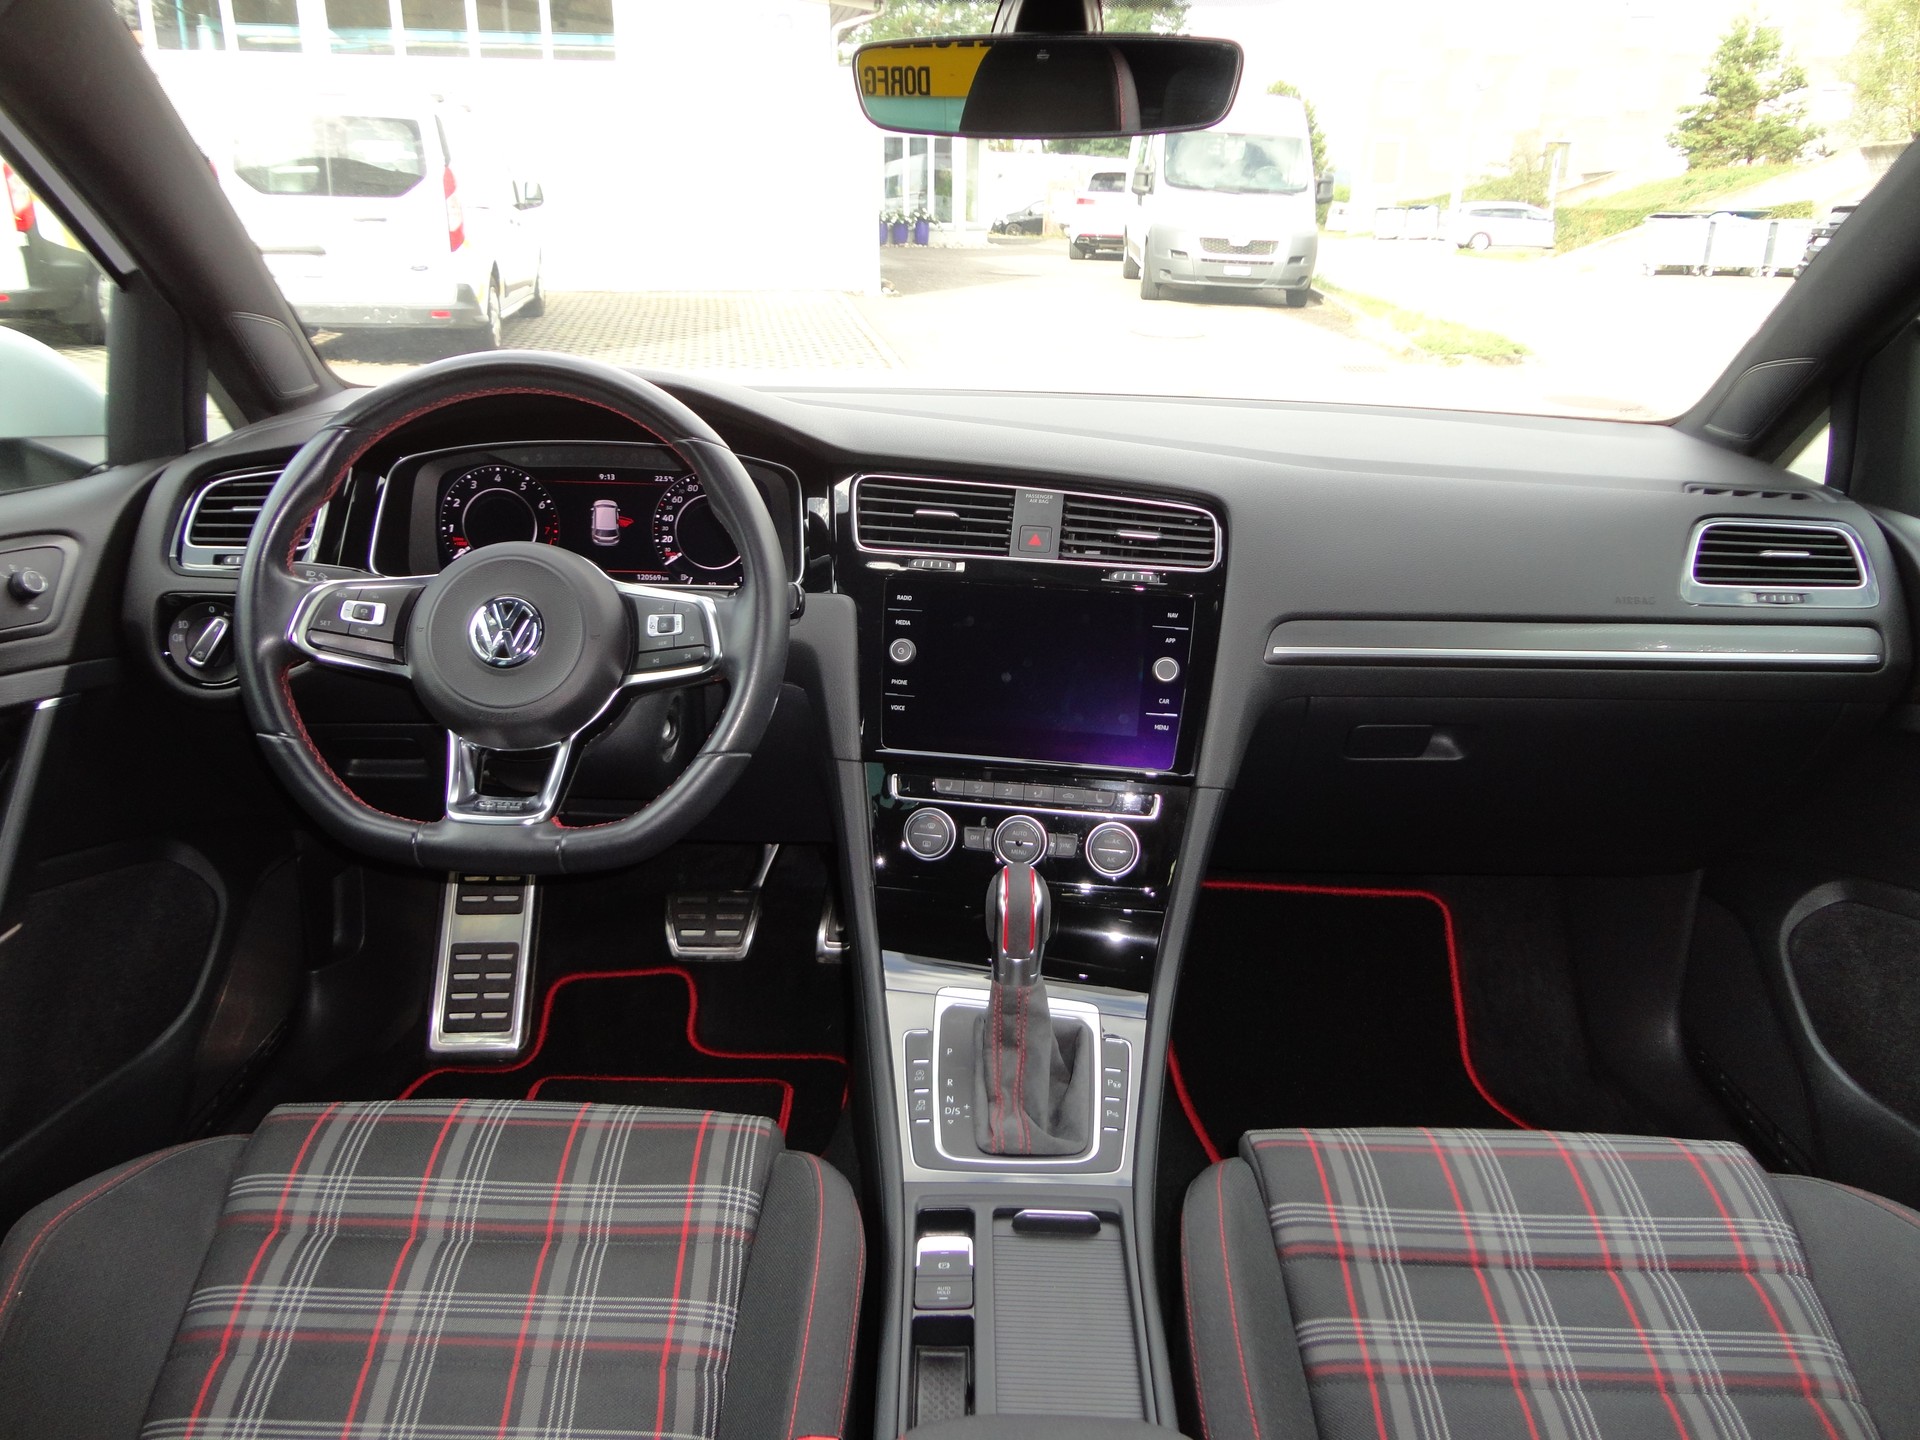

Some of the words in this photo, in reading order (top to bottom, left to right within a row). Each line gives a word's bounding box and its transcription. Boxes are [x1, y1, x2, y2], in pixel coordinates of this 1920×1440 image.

[494, 474, 502, 482] 4
[598, 473, 616, 481] 9:13
[470, 480, 478, 489] 3
[520, 482, 527, 490] 5
[687, 484, 699, 492] 80
[453, 498, 461, 507] 2
[671, 496, 683, 504] 60
[538, 501, 546, 509] 6
[662, 514, 674, 522] 40
[449, 524, 455, 533] 1
[661, 535, 673, 543] 20
[637, 573, 662, 581] 120569
[896, 594, 913, 602] RADIO
[891, 678, 908, 686] PHONE
[1011, 848, 1027, 856] MENU
[946, 1047, 953, 1055] P
[947, 1078, 953, 1086] R
[946, 1095, 954, 1103] N
[944, 1106, 961, 1115] D/S
